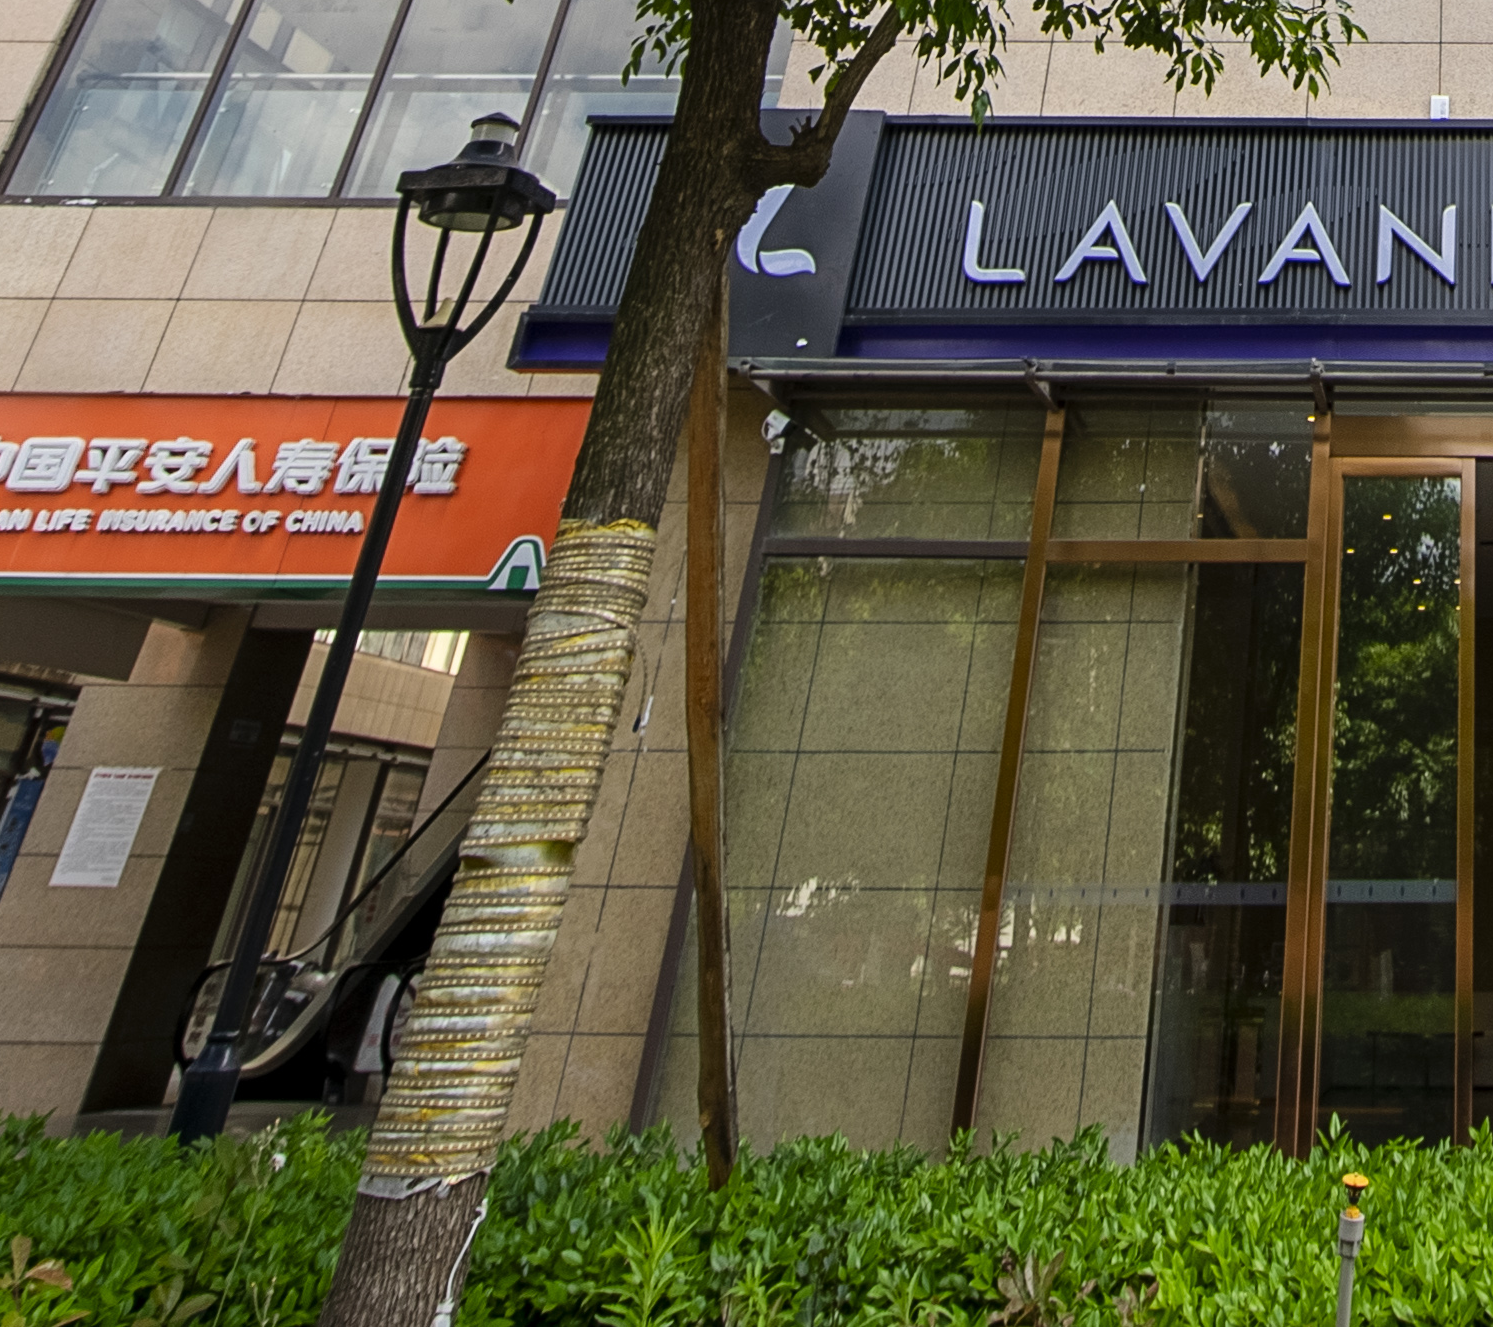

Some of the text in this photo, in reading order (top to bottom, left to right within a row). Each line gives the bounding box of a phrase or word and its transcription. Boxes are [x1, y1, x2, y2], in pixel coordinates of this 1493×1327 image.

[33, 508, 95, 533] LIFE
[95, 508, 238, 534] INSURANCE
[242, 510, 282, 534] OF
[285, 510, 365, 535] CHINA
